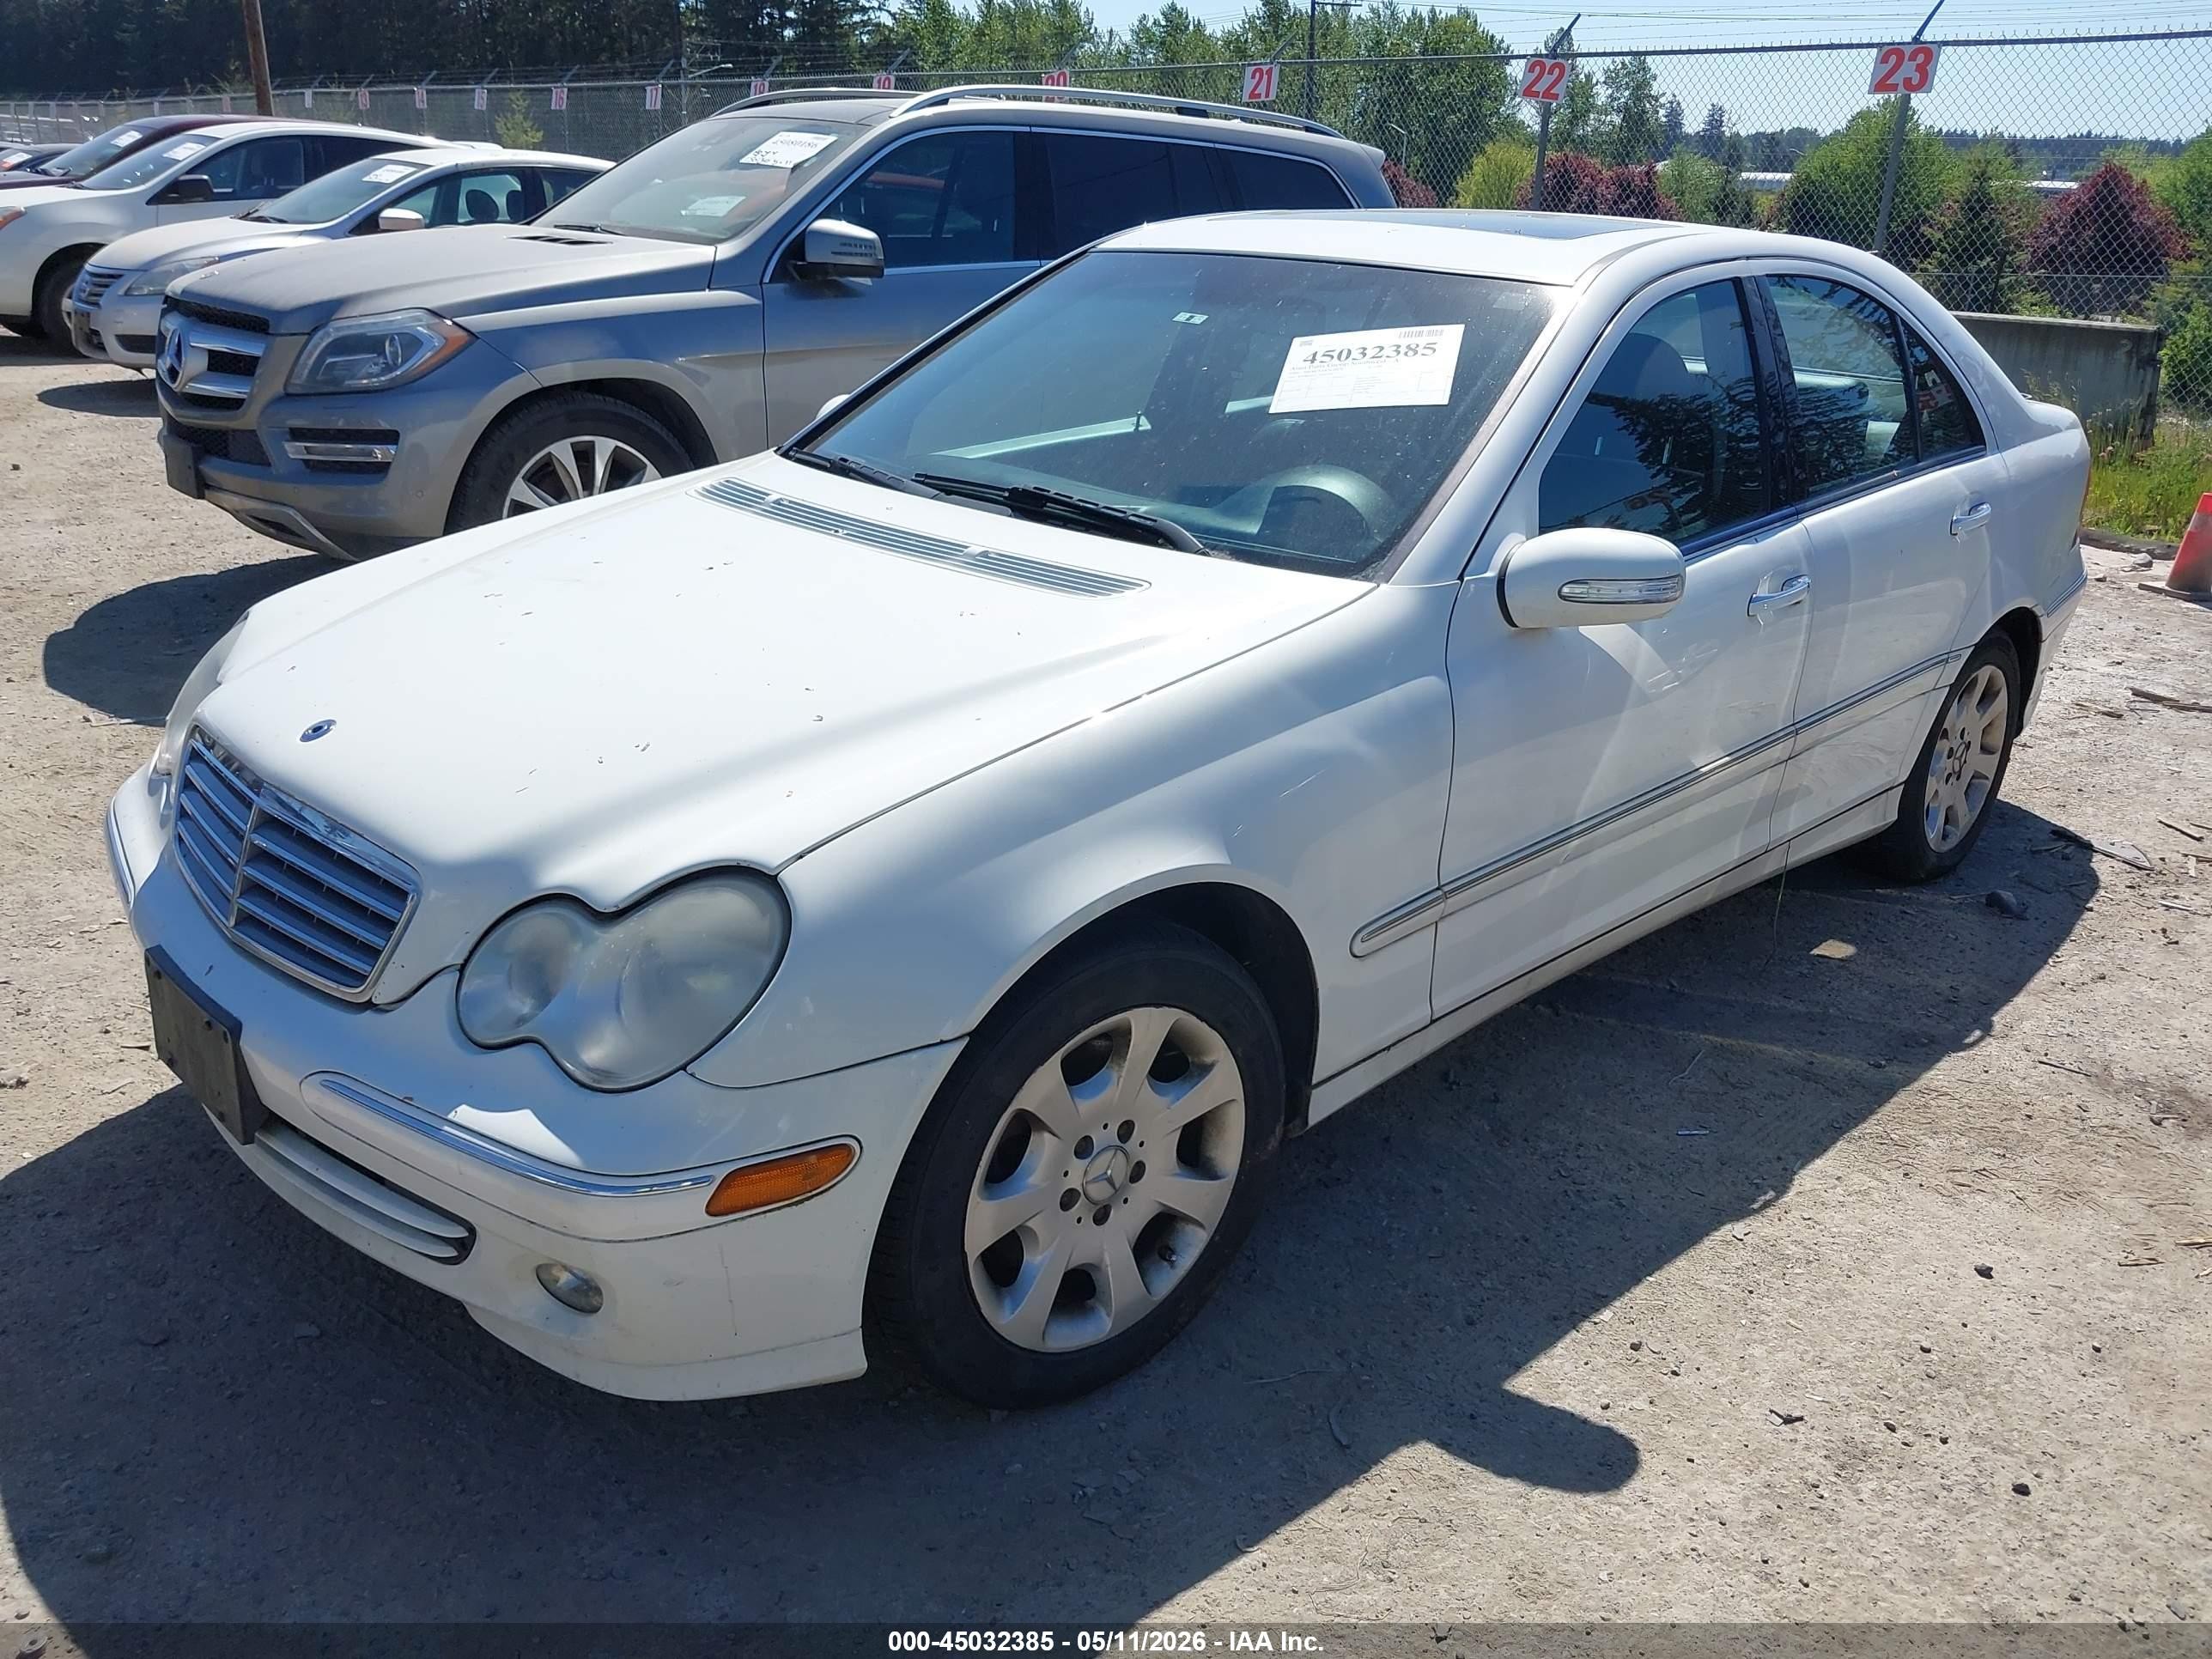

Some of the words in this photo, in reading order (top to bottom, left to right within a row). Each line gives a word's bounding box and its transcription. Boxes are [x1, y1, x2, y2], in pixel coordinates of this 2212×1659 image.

[1248, 66, 1274, 100] 21
[1522, 59, 1567, 101] 22
[1873, 46, 1935, 93] 23
[554, 89, 564, 108] 16
[650, 88, 659, 108] 17
[1301, 342, 1438, 365] 45032385
